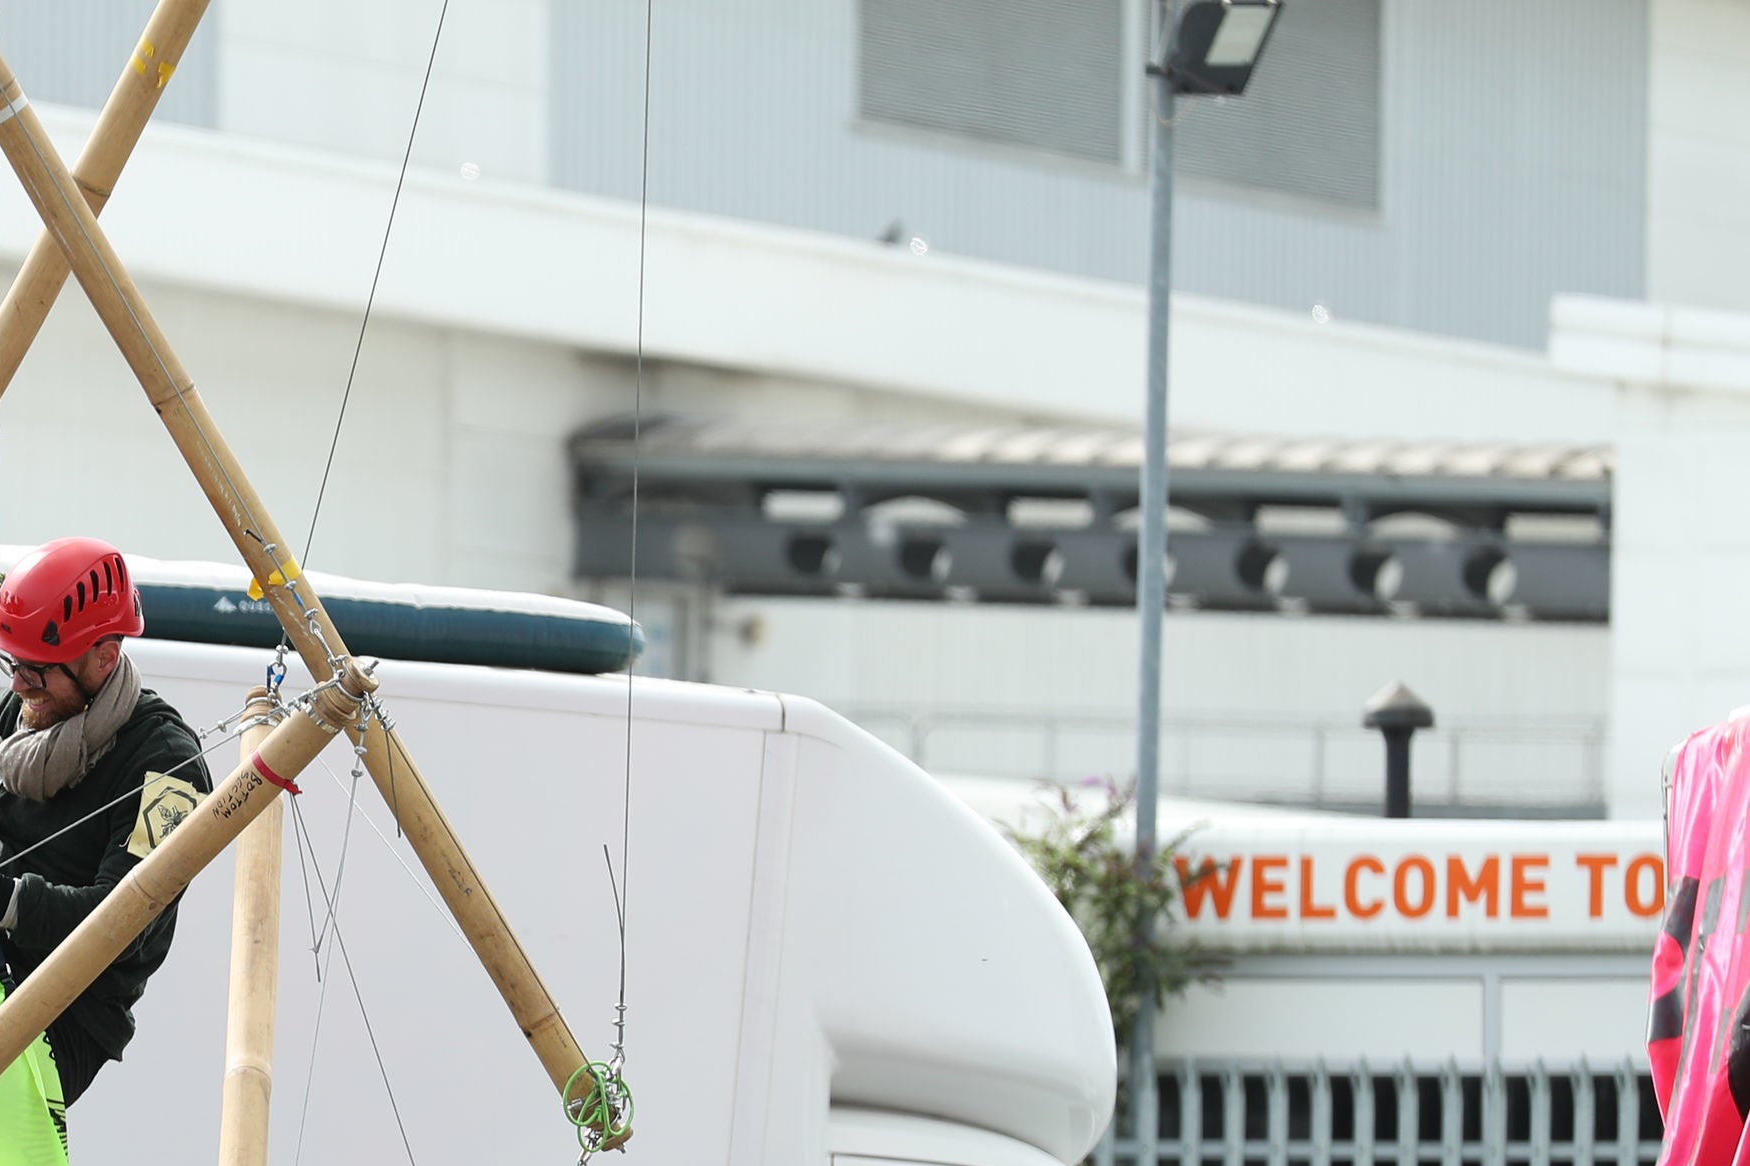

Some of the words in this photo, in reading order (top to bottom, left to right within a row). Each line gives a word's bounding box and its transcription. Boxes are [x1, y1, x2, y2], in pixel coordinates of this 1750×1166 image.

[222, 772, 263, 818] BOTTOM
[1174, 855, 1549, 919] WELCOME
[1576, 855, 1665, 919] TO
